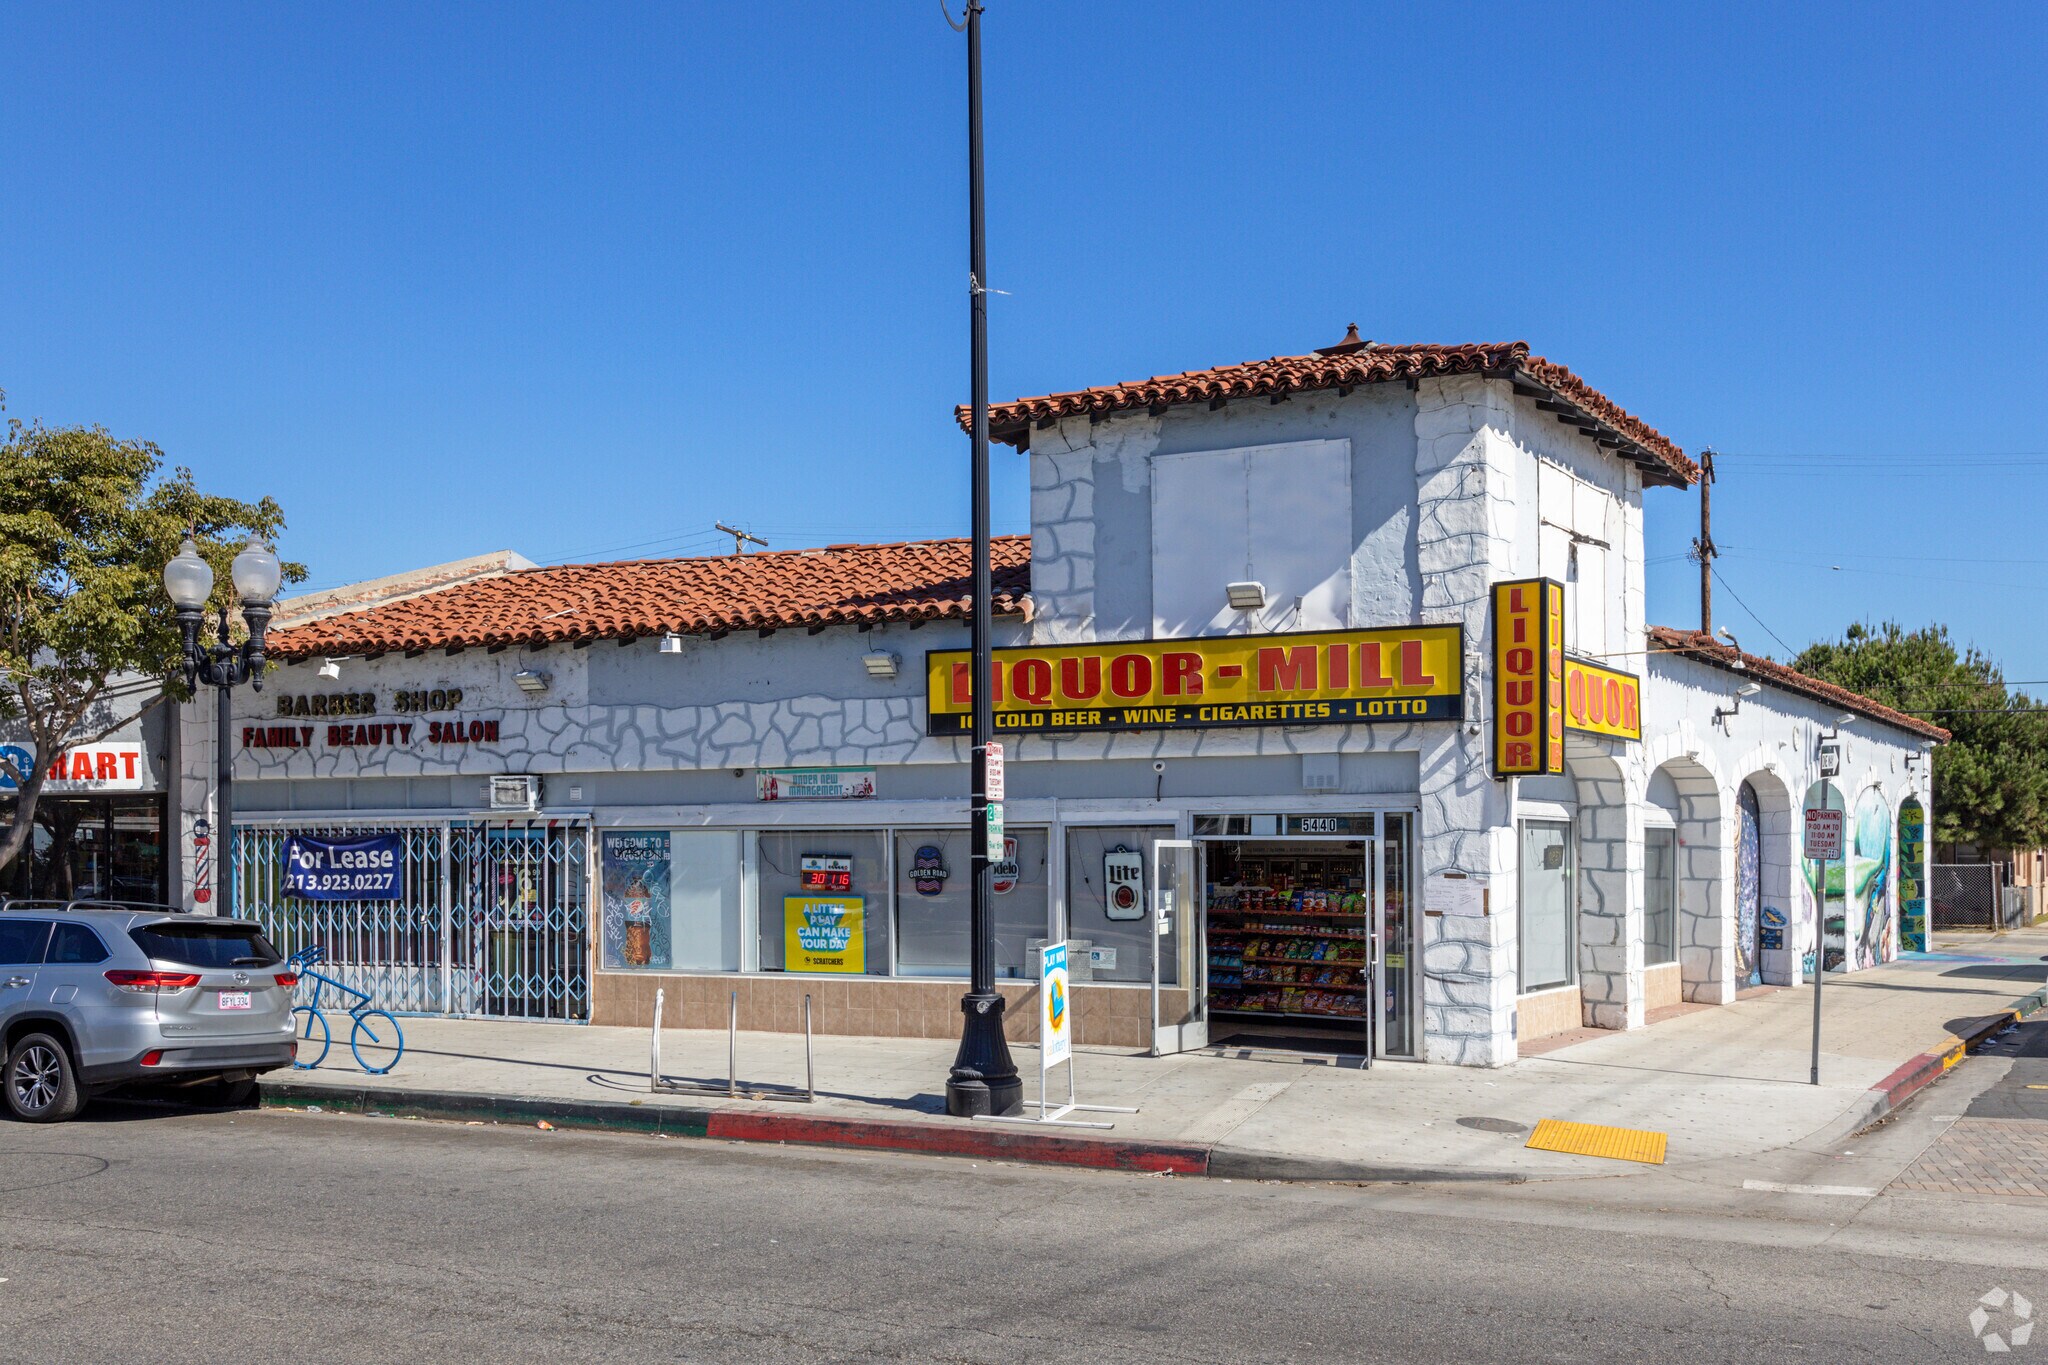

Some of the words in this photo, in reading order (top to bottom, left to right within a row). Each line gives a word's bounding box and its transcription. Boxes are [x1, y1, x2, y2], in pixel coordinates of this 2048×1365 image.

[952, 652, 1204, 706] LIQUOR
[1258, 640, 1435, 692] MILL
[1505, 588, 1534, 768] LIQUOR
[1549, 587, 1562, 768] LIQUOR
[277, 692, 376, 717] BARBER
[394, 688, 464, 713] SHOP
[1566, 669, 1637, 731] QUOR
[995, 712, 1044, 728] COLD
[1051, 710, 1101, 726] BEER
[1123, 708, 1176, 724] WINE
[1199, 702, 1331, 721] CIGARETTES
[1356, 699, 1428, 717] LOTTO
[242, 727, 315, 748] FAMILY
[327, 723, 414, 747] BEAUTY
[428, 720, 499, 744] SALON
[793, 774, 818, 785] UNDER
[821, 773, 838, 784] NEW
[789, 784, 843, 796] MANAGEMENT
[1806, 811, 1816, 821] NO
[1816, 811, 1840, 821] PARKING
[1302, 818, 1336, 832] 5440
[1822, 823, 1830, 831] AM
[606, 837, 648, 849] WELCOME
[650, 837, 662, 849] TO
[1810, 839, 1836, 847] TUESDAY
[289, 845, 324, 869] For
[328, 846, 394, 869] Lease
[909, 870, 931, 878] GOLDEN
[932, 869, 947, 878] ROAD
[993, 863, 1017, 875] delo
[1108, 865, 1140, 885] Lite
[286, 873, 394, 891] 213.923.0227
[803, 903, 811, 914] A
[813, 903, 845, 914] LITTLE
[797, 927, 820, 937] CAN
[822, 927, 851, 937] MAKE
[800, 938, 827, 949] YOUR
[829, 938, 849, 949] DAY
[813, 957, 844, 966] SCRATCHERS
[1044, 953, 1055, 968] PLAY
